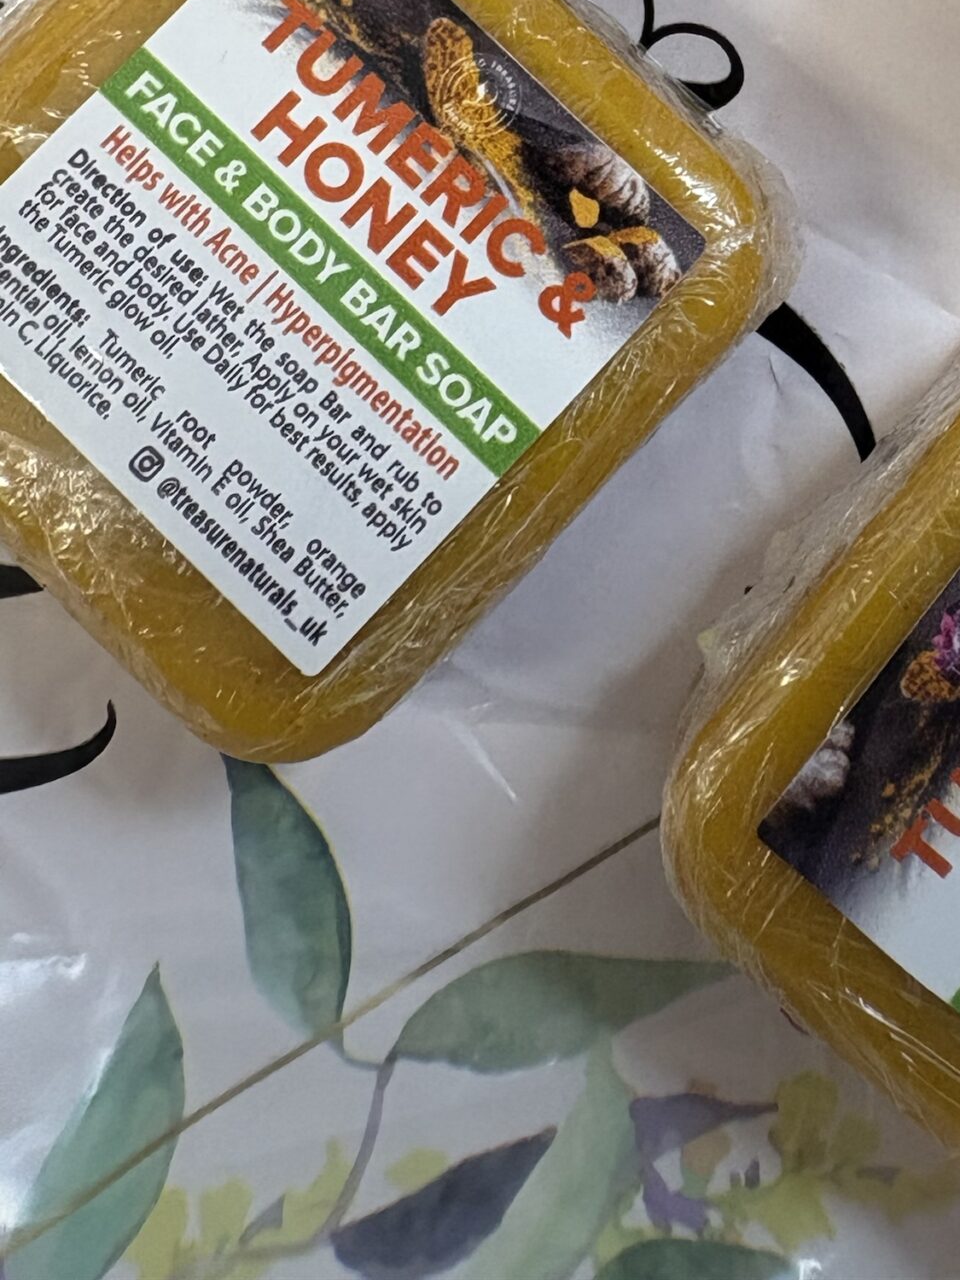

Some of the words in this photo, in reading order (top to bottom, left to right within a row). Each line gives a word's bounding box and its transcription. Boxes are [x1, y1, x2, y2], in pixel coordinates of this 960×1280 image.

[67, 148, 146, 228] Direction
[147, 228, 175, 249] of
[170, 249, 208, 287] use:
[206, 280, 244, 322] Wet
[243, 318, 274, 352] the
[274, 352, 318, 393] soap
[318, 390, 352, 424] Bar
[350, 425, 390, 461] and
[386, 459, 419, 492] rub
[420, 491, 442, 515] to
[99, 124, 164, 191] Helps
[159, 182, 211, 238] with
[203, 227, 259, 285] Acne
[264, 282, 459, 480] Hyperpigmentation
[124, 70, 224, 167] FACE
[213, 159, 246, 194] &
[241, 182, 350, 284] BODY
[339, 278, 420, 360] BAR
[416, 352, 516, 443] SOAP
[251, 90, 495, 314] HONEY
[538, 269, 598, 337] &
[156, 477, 327, 647] @treasurenaturals_uk
